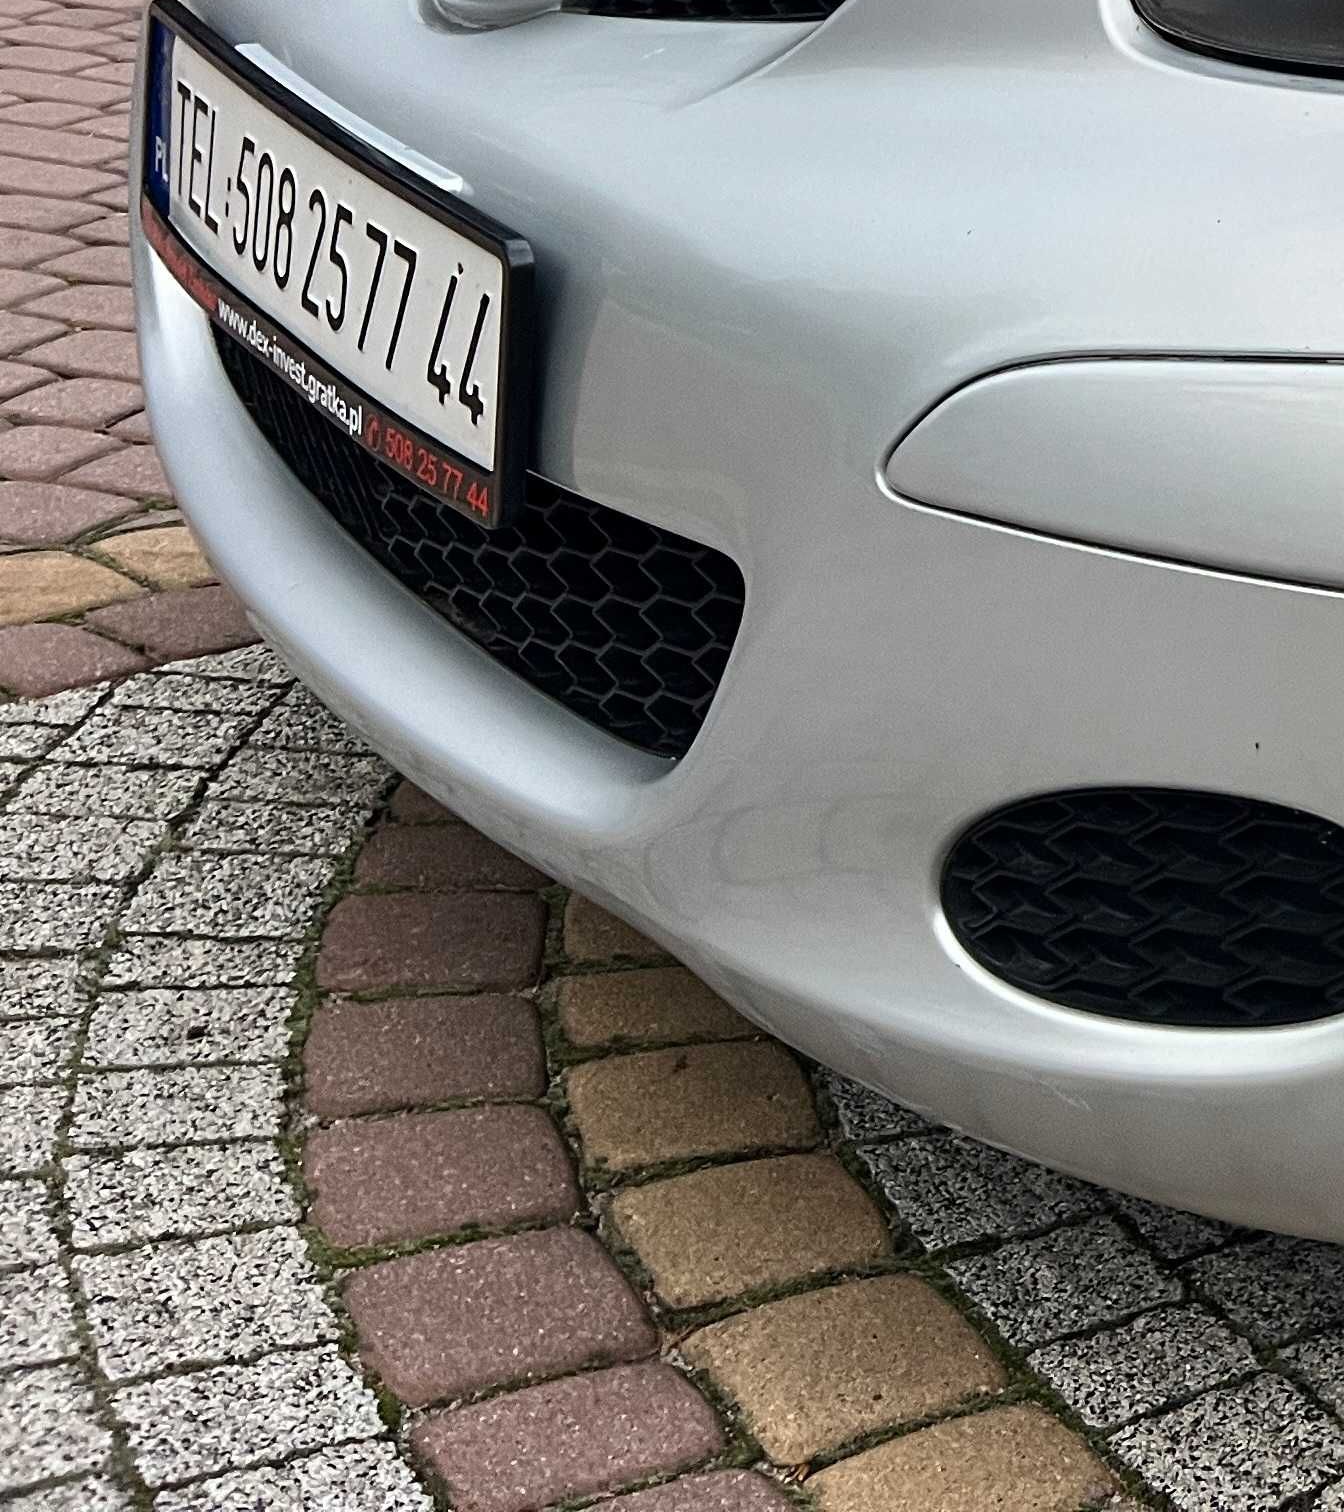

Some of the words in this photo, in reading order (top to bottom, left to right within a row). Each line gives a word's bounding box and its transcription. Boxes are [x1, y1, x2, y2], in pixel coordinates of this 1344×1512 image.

[217, 298, 363, 436] www.dex-invest.gratka.pl
[386, 428, 414, 470] 508
[416, 447, 437, 487] 25
[442, 466, 463, 501] 77
[467, 482, 489, 517] 44
